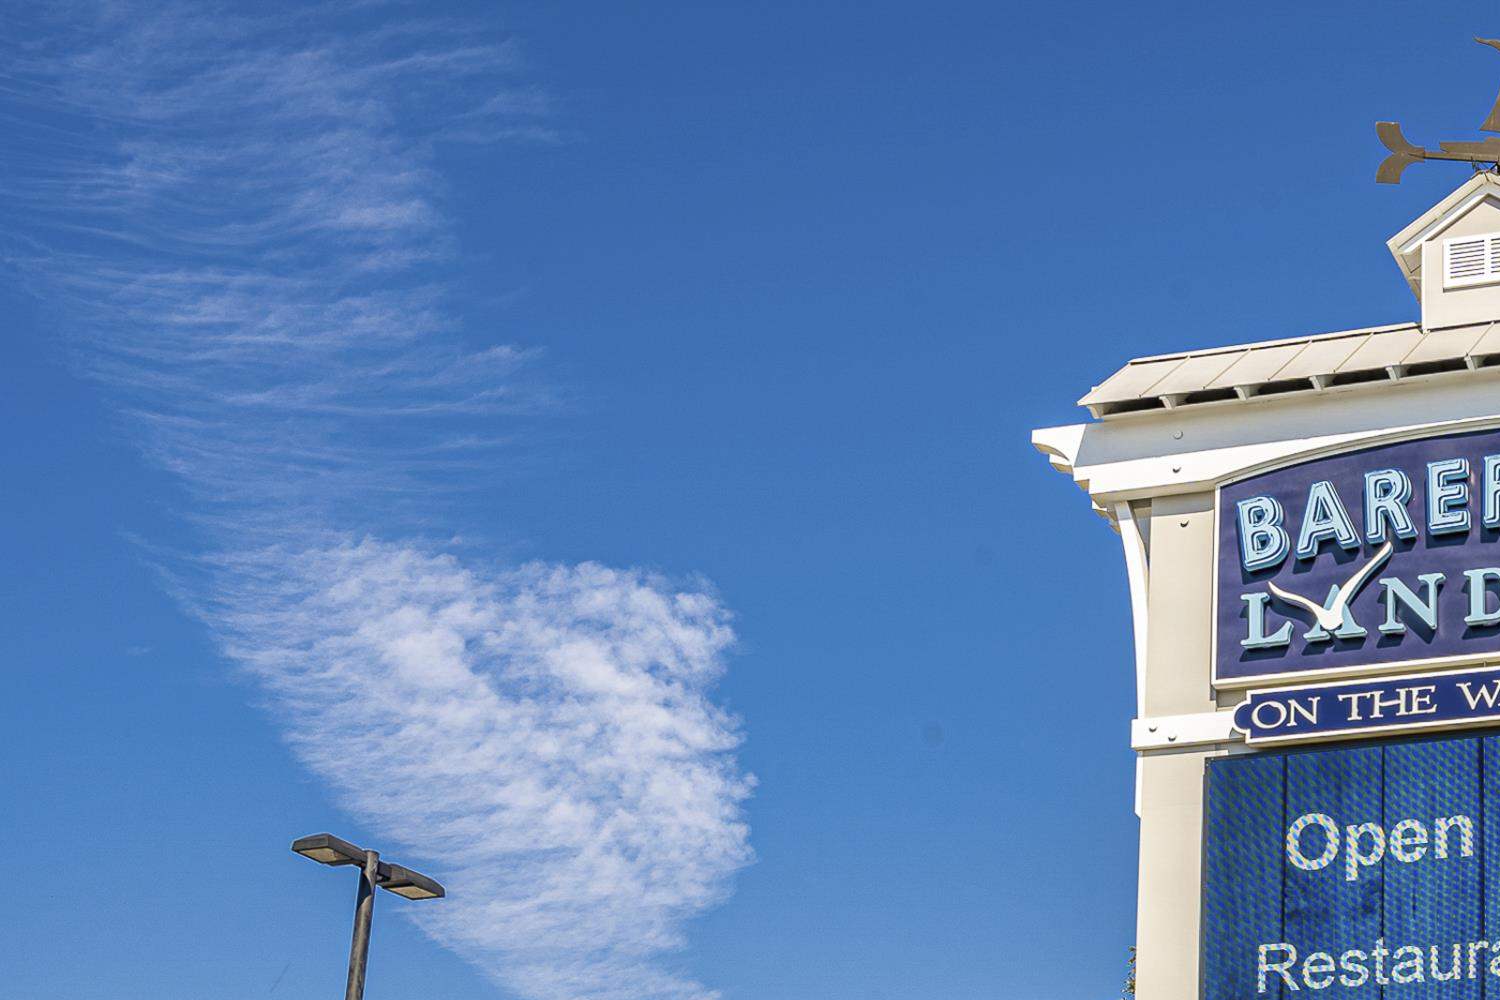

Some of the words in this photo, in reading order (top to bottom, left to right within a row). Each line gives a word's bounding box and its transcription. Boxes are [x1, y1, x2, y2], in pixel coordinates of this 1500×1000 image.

[1251, 696, 1317, 729] ON
[1338, 685, 1436, 722] THE
[1285, 811, 1474, 881] Open
